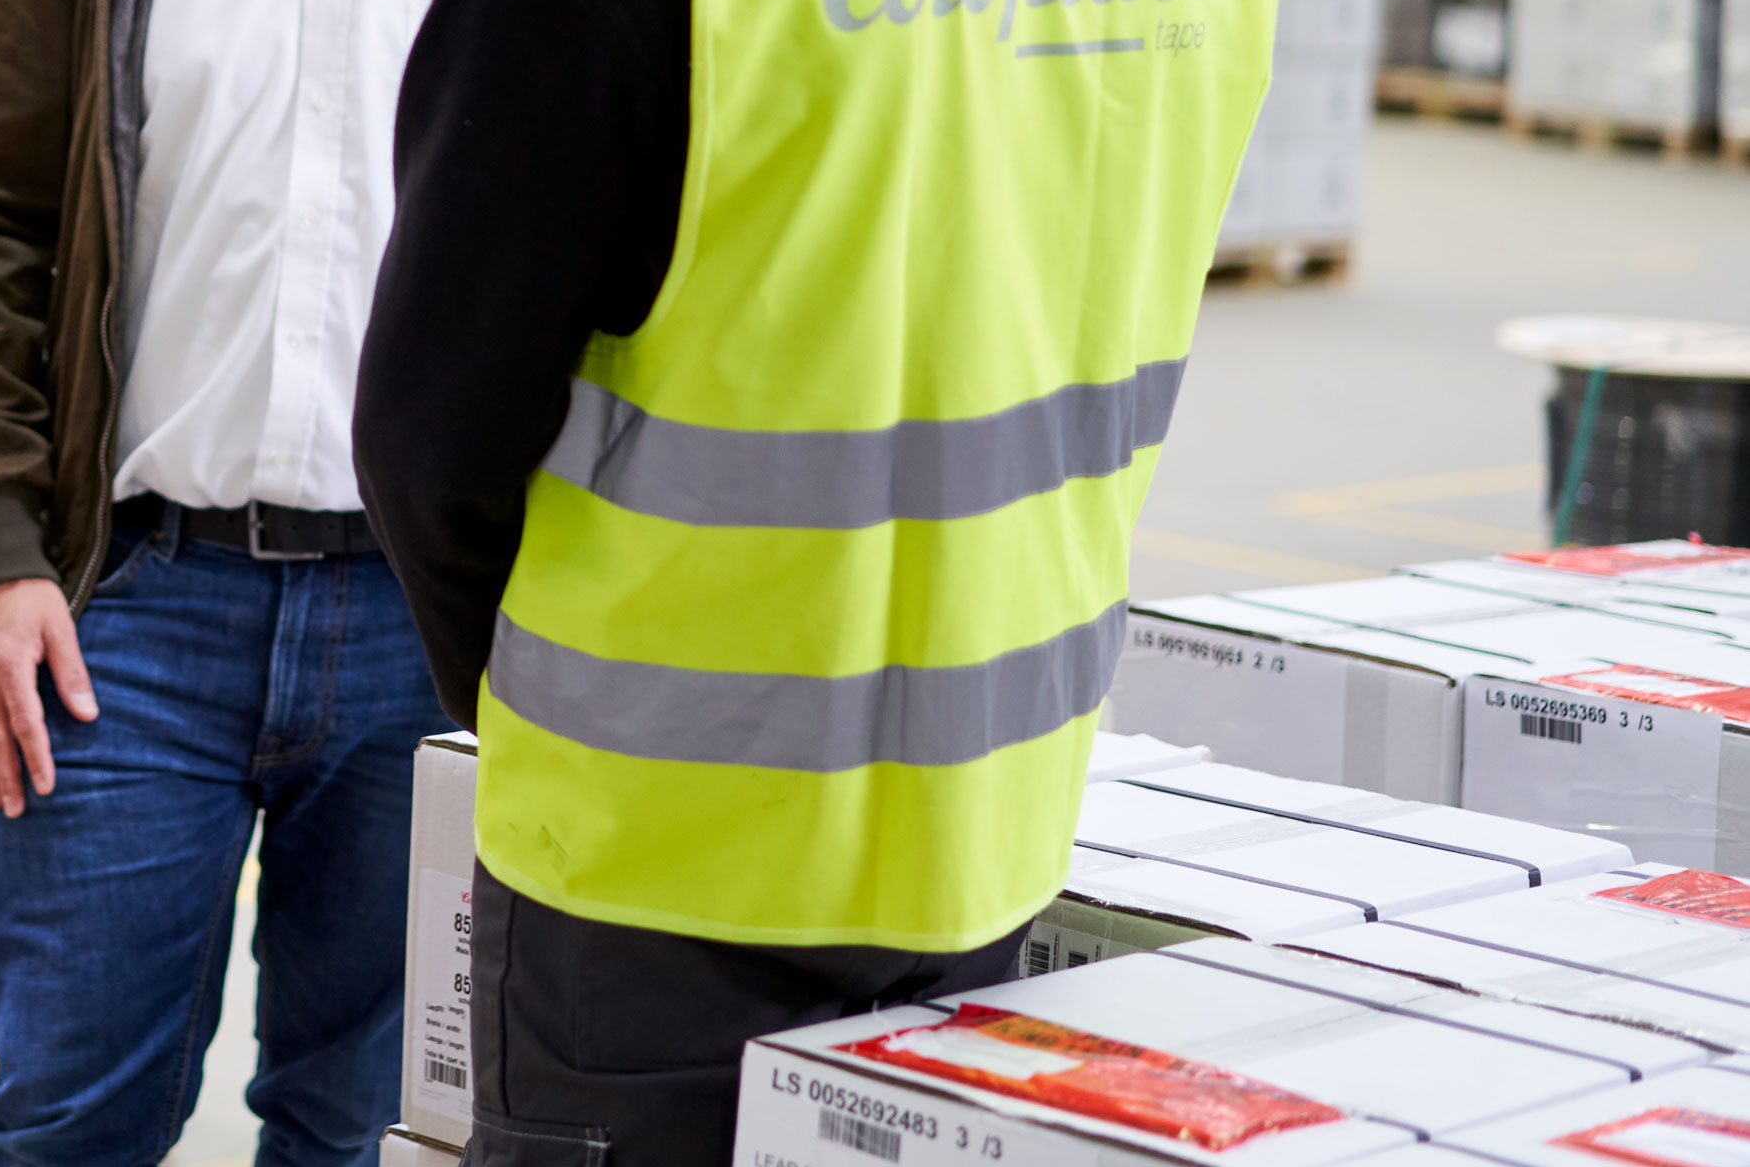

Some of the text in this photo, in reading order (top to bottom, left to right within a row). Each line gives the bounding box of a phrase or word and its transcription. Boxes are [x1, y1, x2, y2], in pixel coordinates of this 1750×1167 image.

[1155, 18, 1206, 59] tape
[1252, 651, 1264, 670] 2
[1269, 655, 1286, 674] /3
[1485, 687, 1654, 732] LS 0052695369 3 /3
[771, 1067, 1003, 1161] LS 0052692483 3 /3
